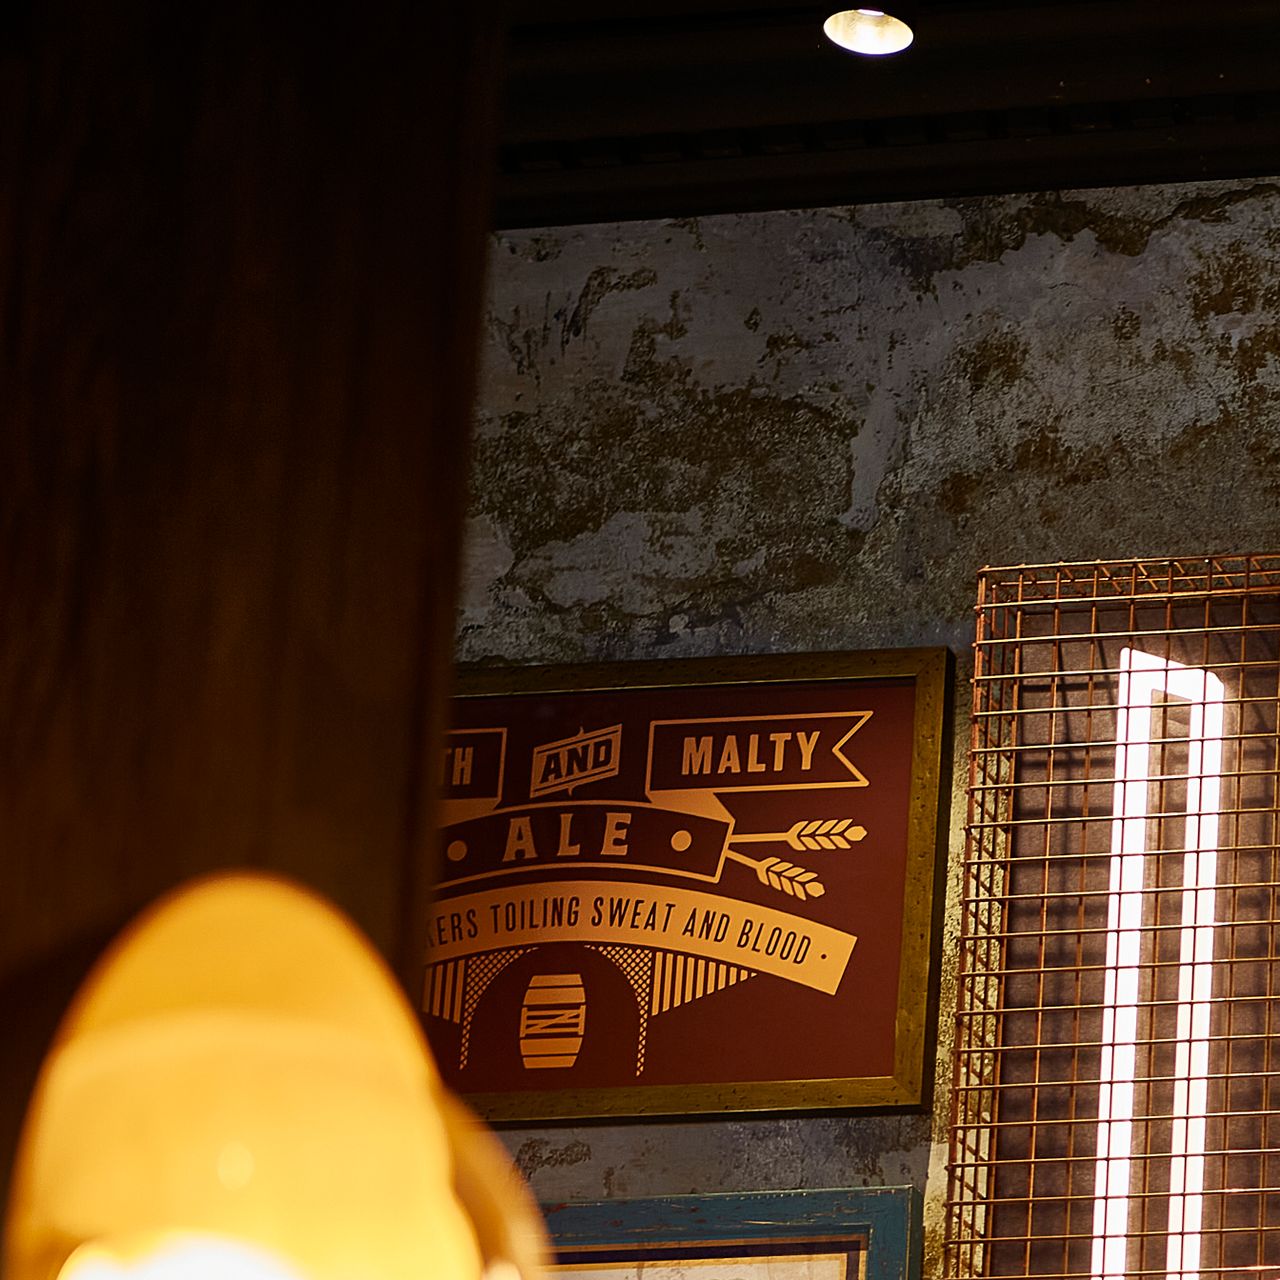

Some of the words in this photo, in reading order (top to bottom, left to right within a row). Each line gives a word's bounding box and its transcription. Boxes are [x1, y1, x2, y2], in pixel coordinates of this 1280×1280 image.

[540, 742, 613, 783] AND
[681, 731, 821, 775] MALTY
[502, 812, 633, 862] ALE
[489, 896, 580, 934] TOILING
[590, 898, 677, 933] SWEAT
[682, 907, 731, 944] AND
[737, 919, 812, 966] BLOOD
